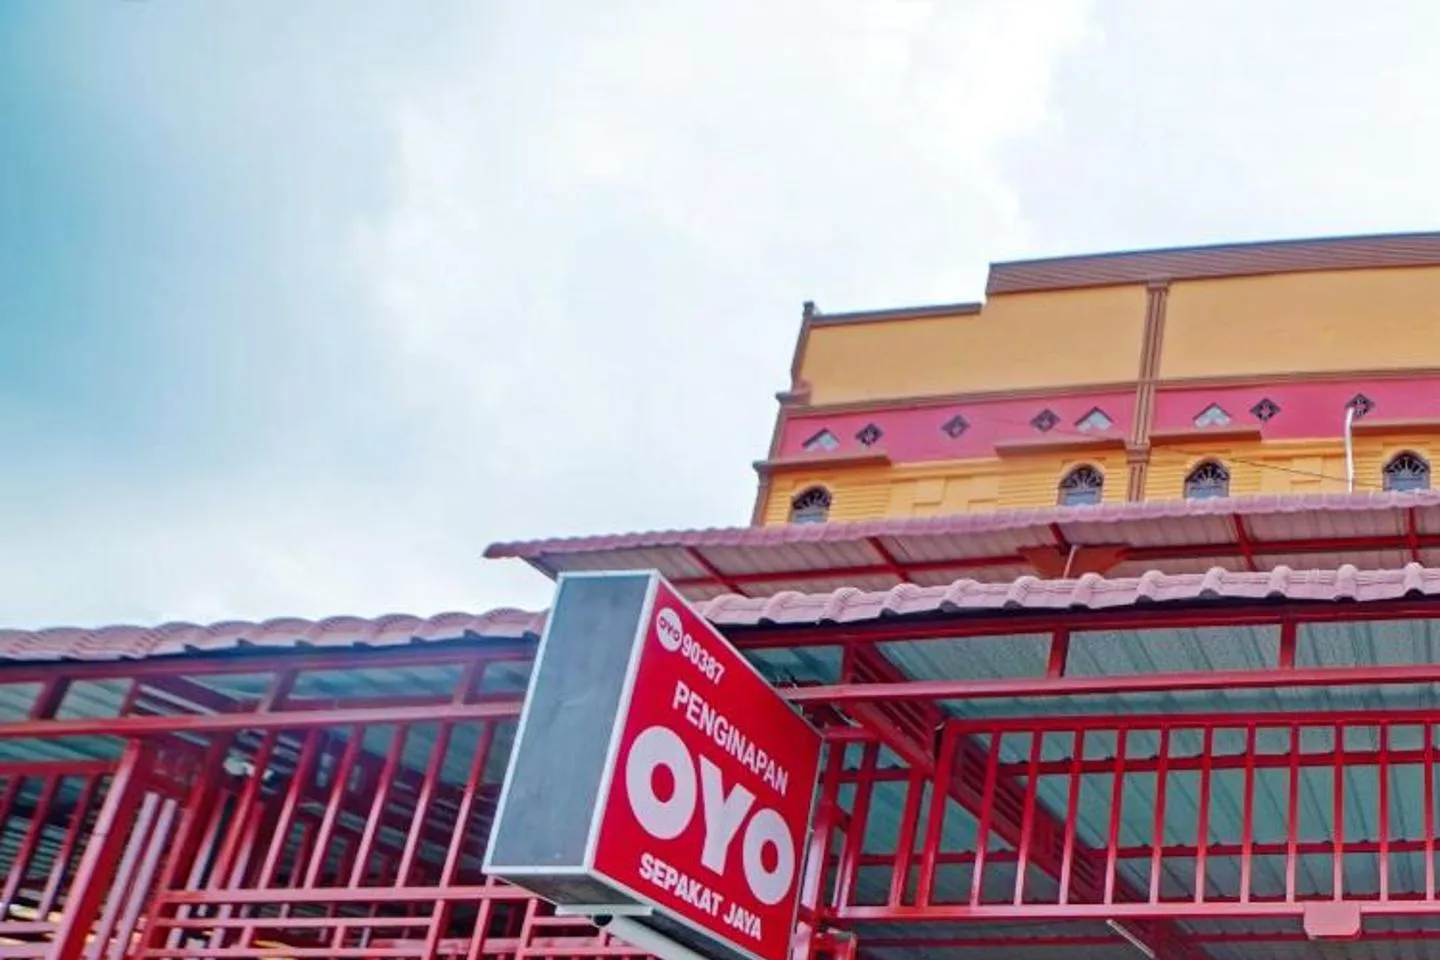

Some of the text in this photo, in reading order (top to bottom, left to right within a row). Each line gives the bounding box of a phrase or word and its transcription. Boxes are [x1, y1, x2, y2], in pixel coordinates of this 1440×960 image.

[682, 632, 726, 685] 90387
[672, 680, 789, 797] PENGINAPAN
[625, 725, 796, 906] OYO
[639, 852, 762, 941] SEPAKAT JAYA
